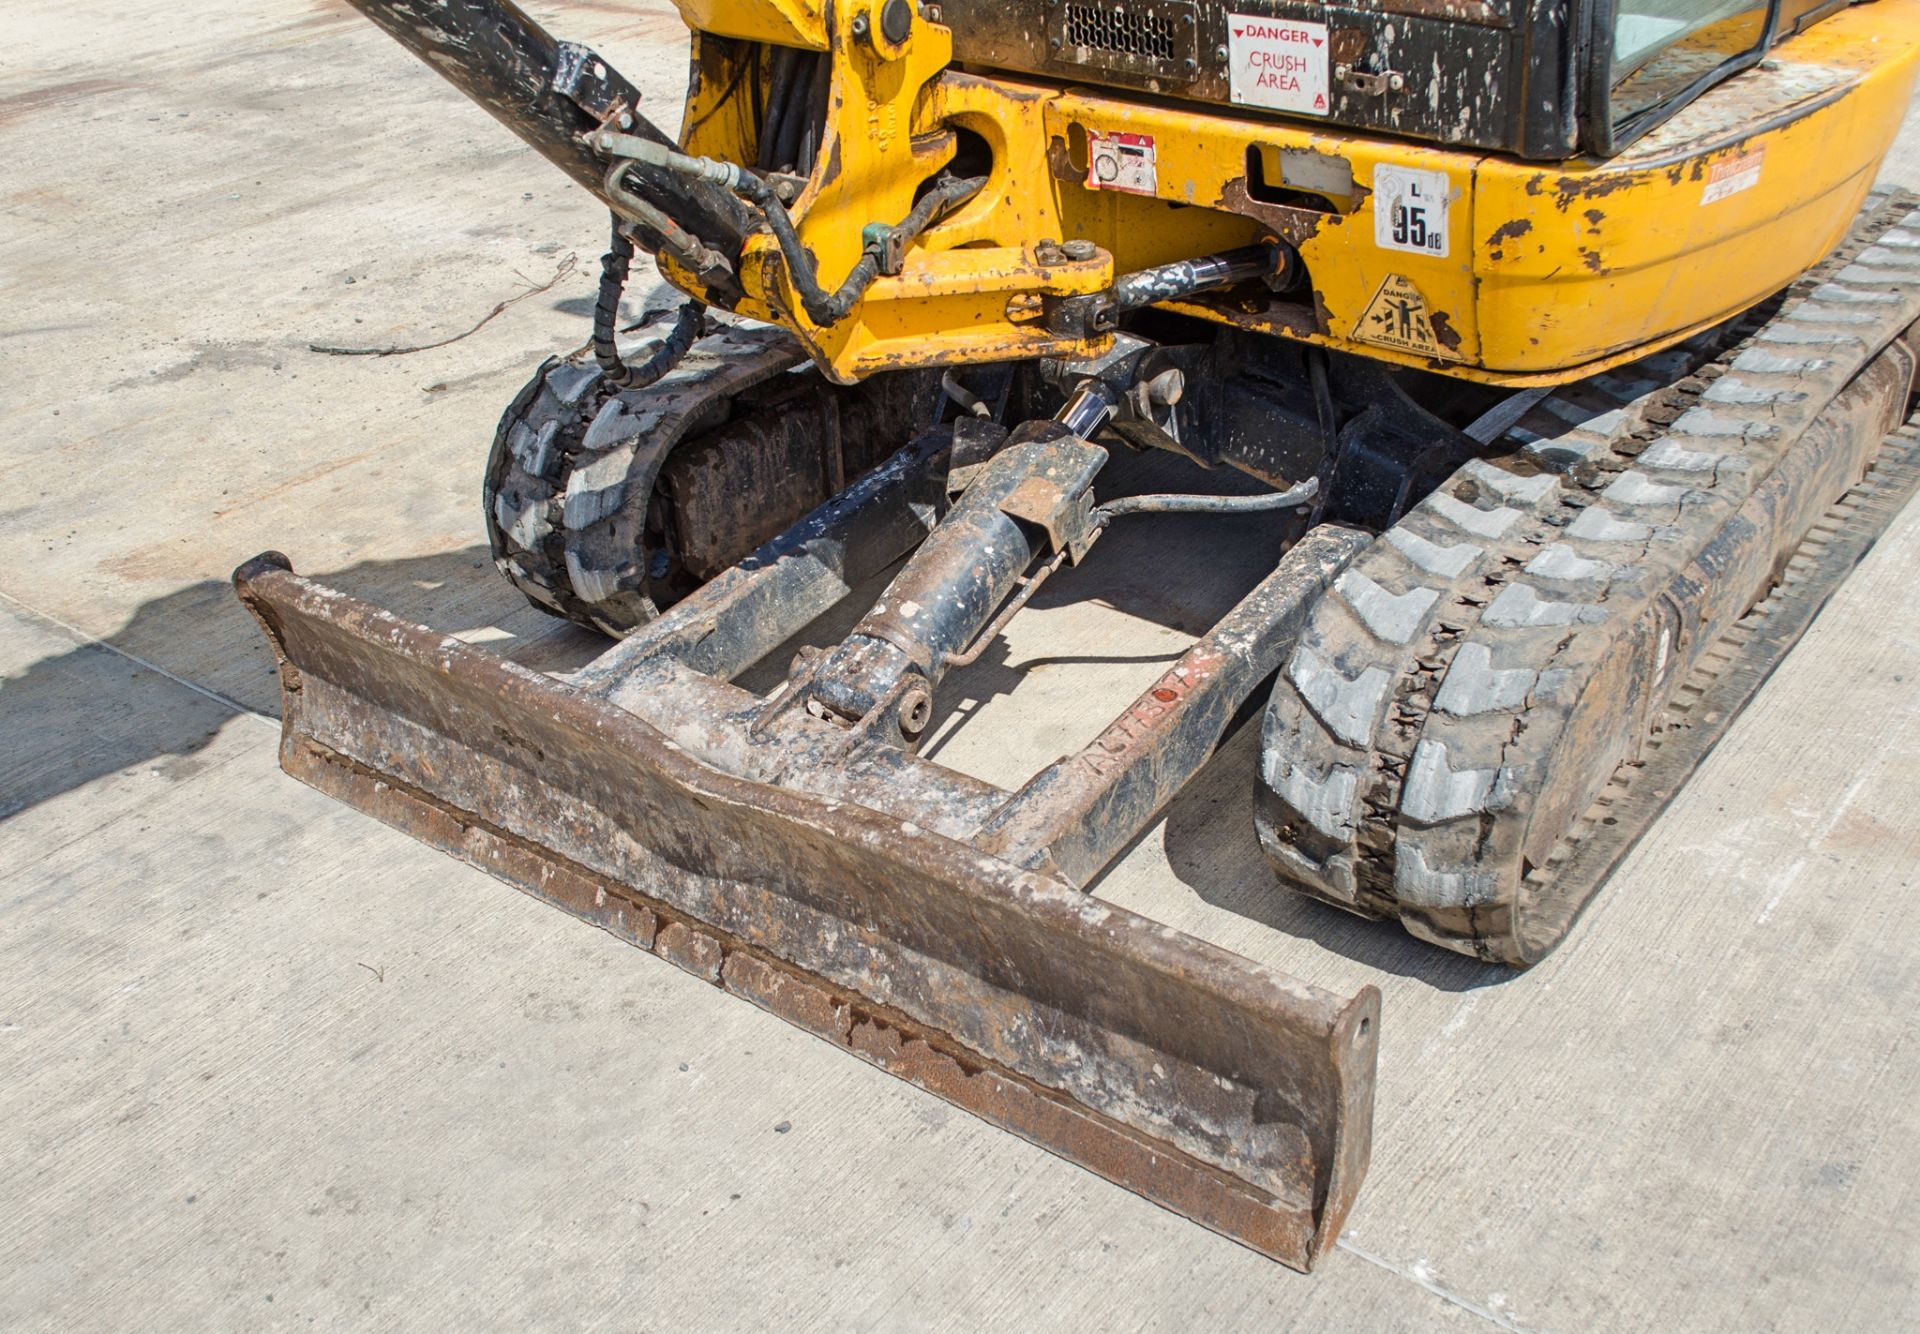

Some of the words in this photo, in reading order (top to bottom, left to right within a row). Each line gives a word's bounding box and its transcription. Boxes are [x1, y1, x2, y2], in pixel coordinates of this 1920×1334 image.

[1246, 25, 1309, 43] DANGER
[1249, 51, 1306, 73] CRUSH
[1256, 72, 1300, 92] AREA
[1411, 183, 1421, 197] L
[1392, 205, 1426, 247] 95
[1383, 289, 1422, 301] DANGR
[1376, 335, 1409, 347] CRUSH
